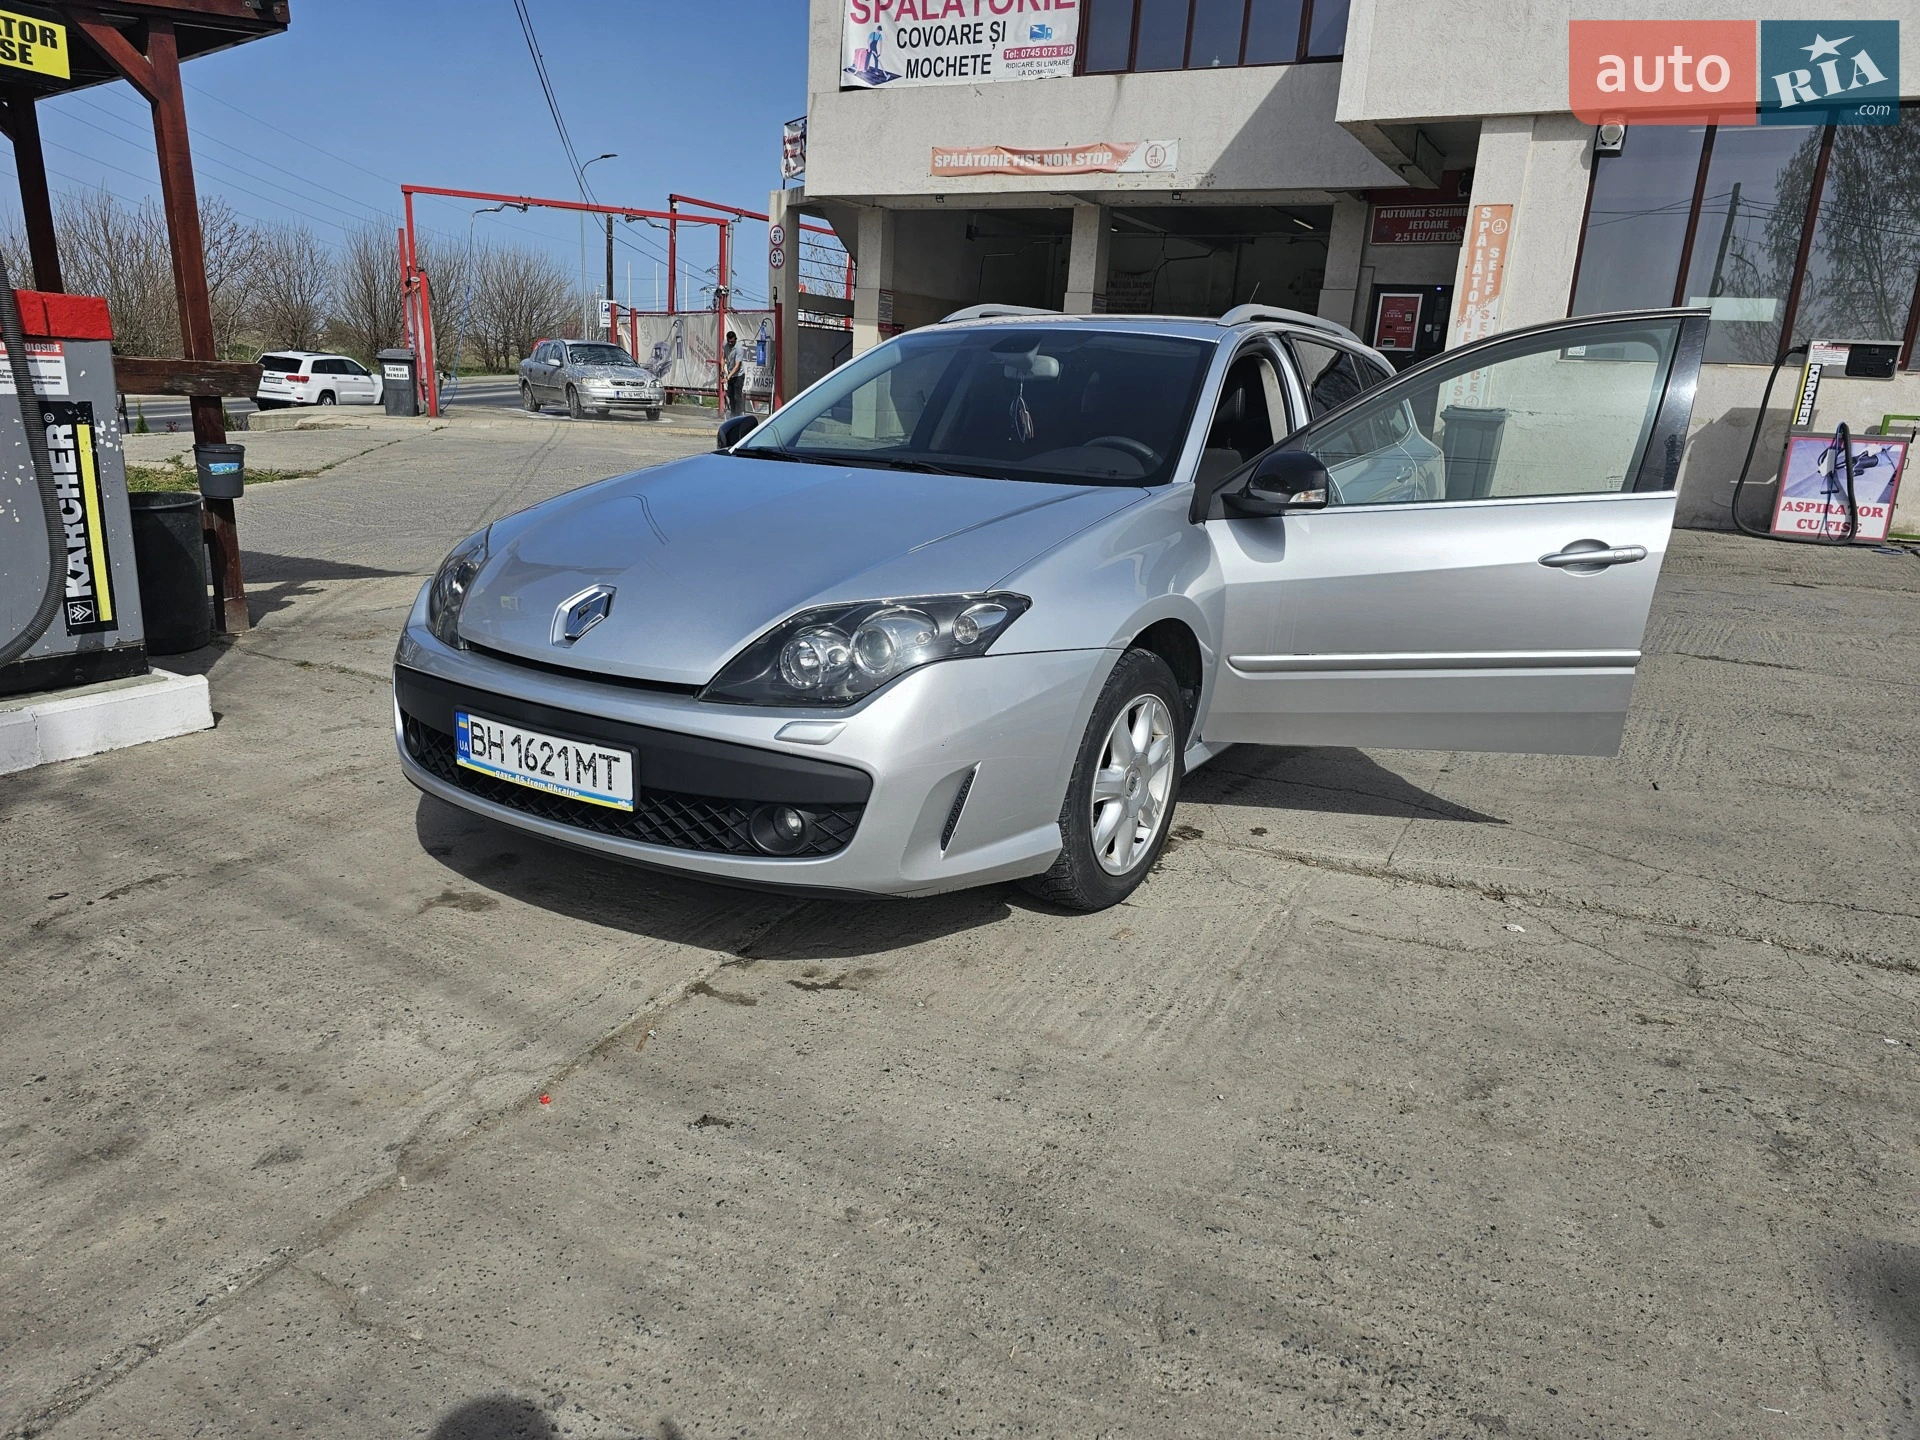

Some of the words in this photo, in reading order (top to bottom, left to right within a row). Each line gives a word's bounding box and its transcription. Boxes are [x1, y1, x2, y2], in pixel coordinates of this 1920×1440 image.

[0, 15, 58, 49] TOR
[896, 22, 984, 49] COVOARE
[1005, 50, 1019, 59] Tel:
[1021, 47, 1040, 58] 0745
[1042, 47, 1058, 57] 073
[1059, 45, 1074, 56] 148
[905, 53, 992, 79] MOCHETE
[1005, 61, 1034, 69] RIDICARE
[1044, 59, 1070, 67] LIVRARE
[934, 152, 1011, 168] SPĂLĂTORIE
[1043, 153, 1073, 167] NON
[1075, 152, 1113, 166] STOP
[1380, 208, 1428, 219] AUTOMAT
[1408, 220, 1450, 230] JETOANE
[1485, 248, 1500, 296] SELF
[25, 343, 61, 353] OLOSIRE
[753, 376, 774, 388] WASH
[1796, 518, 1820, 530] CU
[459, 740, 469, 751] UA
[470, 721, 505, 764] BH
[547, 783, 580, 798] Ukraine
